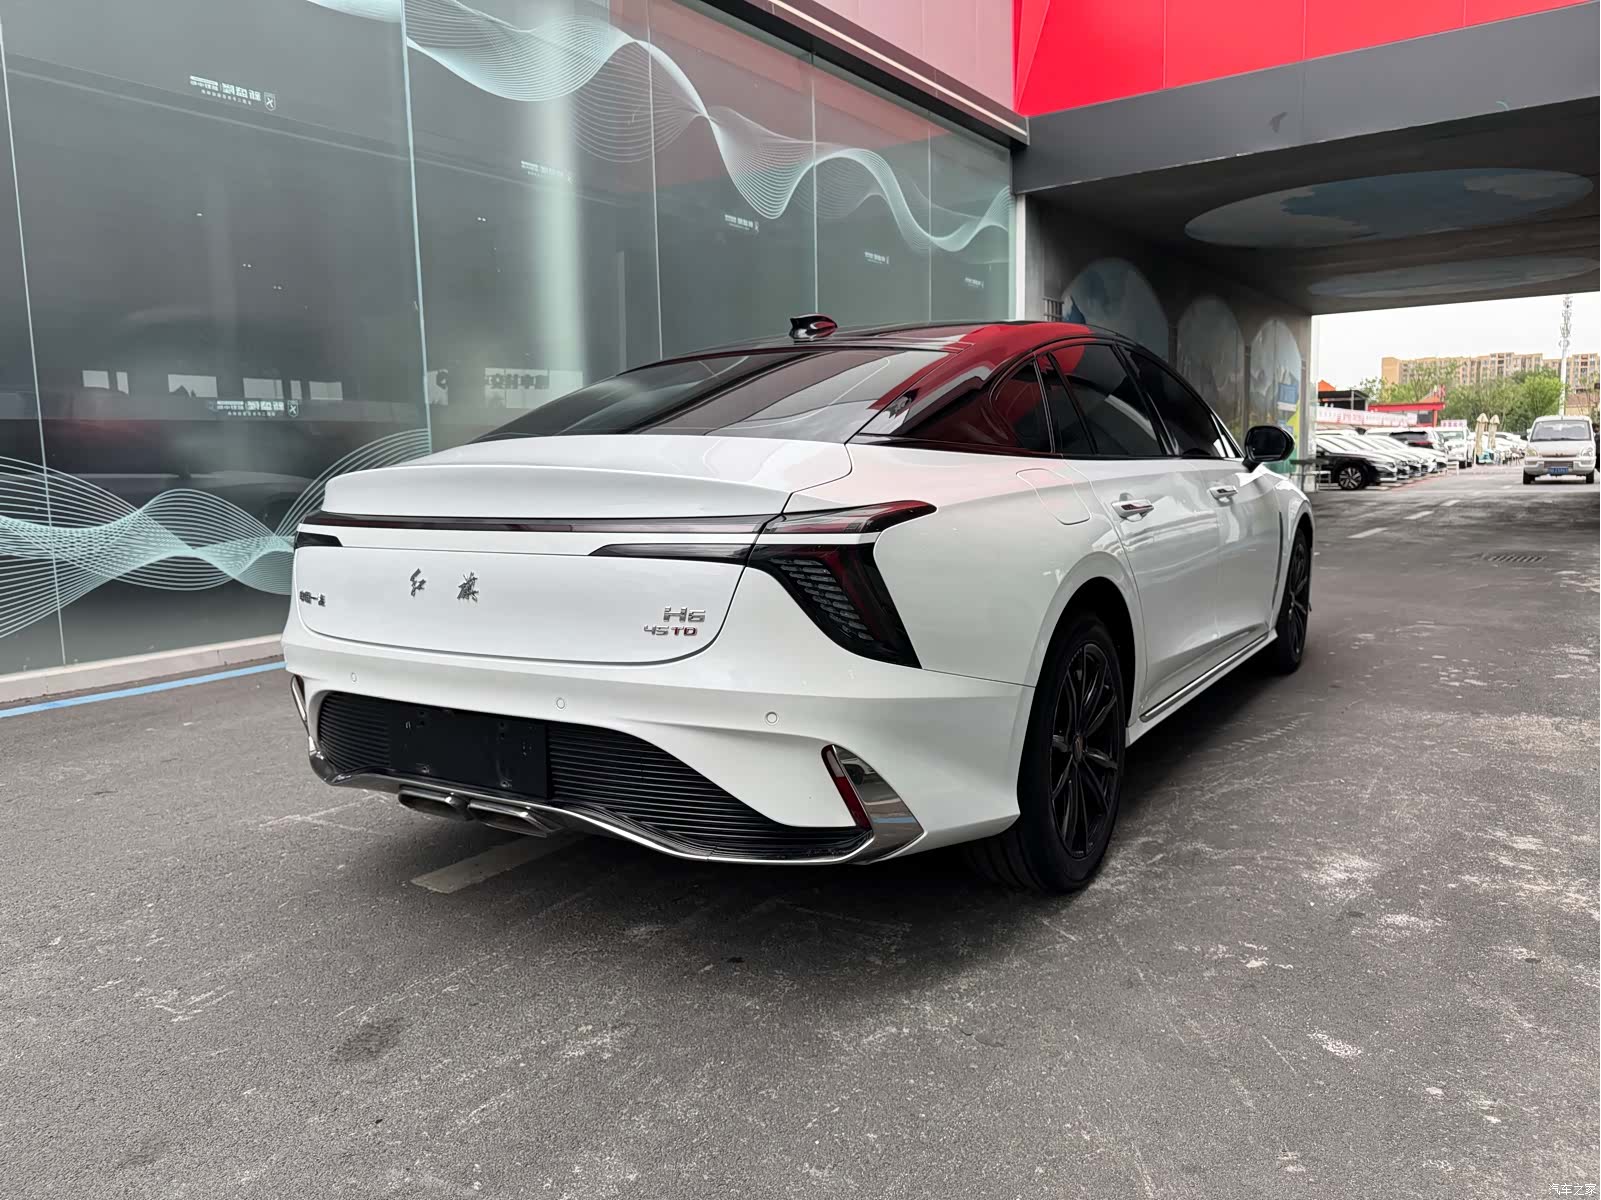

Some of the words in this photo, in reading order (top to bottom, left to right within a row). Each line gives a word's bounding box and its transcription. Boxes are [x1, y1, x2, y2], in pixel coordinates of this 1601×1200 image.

[410, 568, 479, 602] 红旗
[663, 606, 706, 623] H6
[643, 624, 698, 637] 45TD
